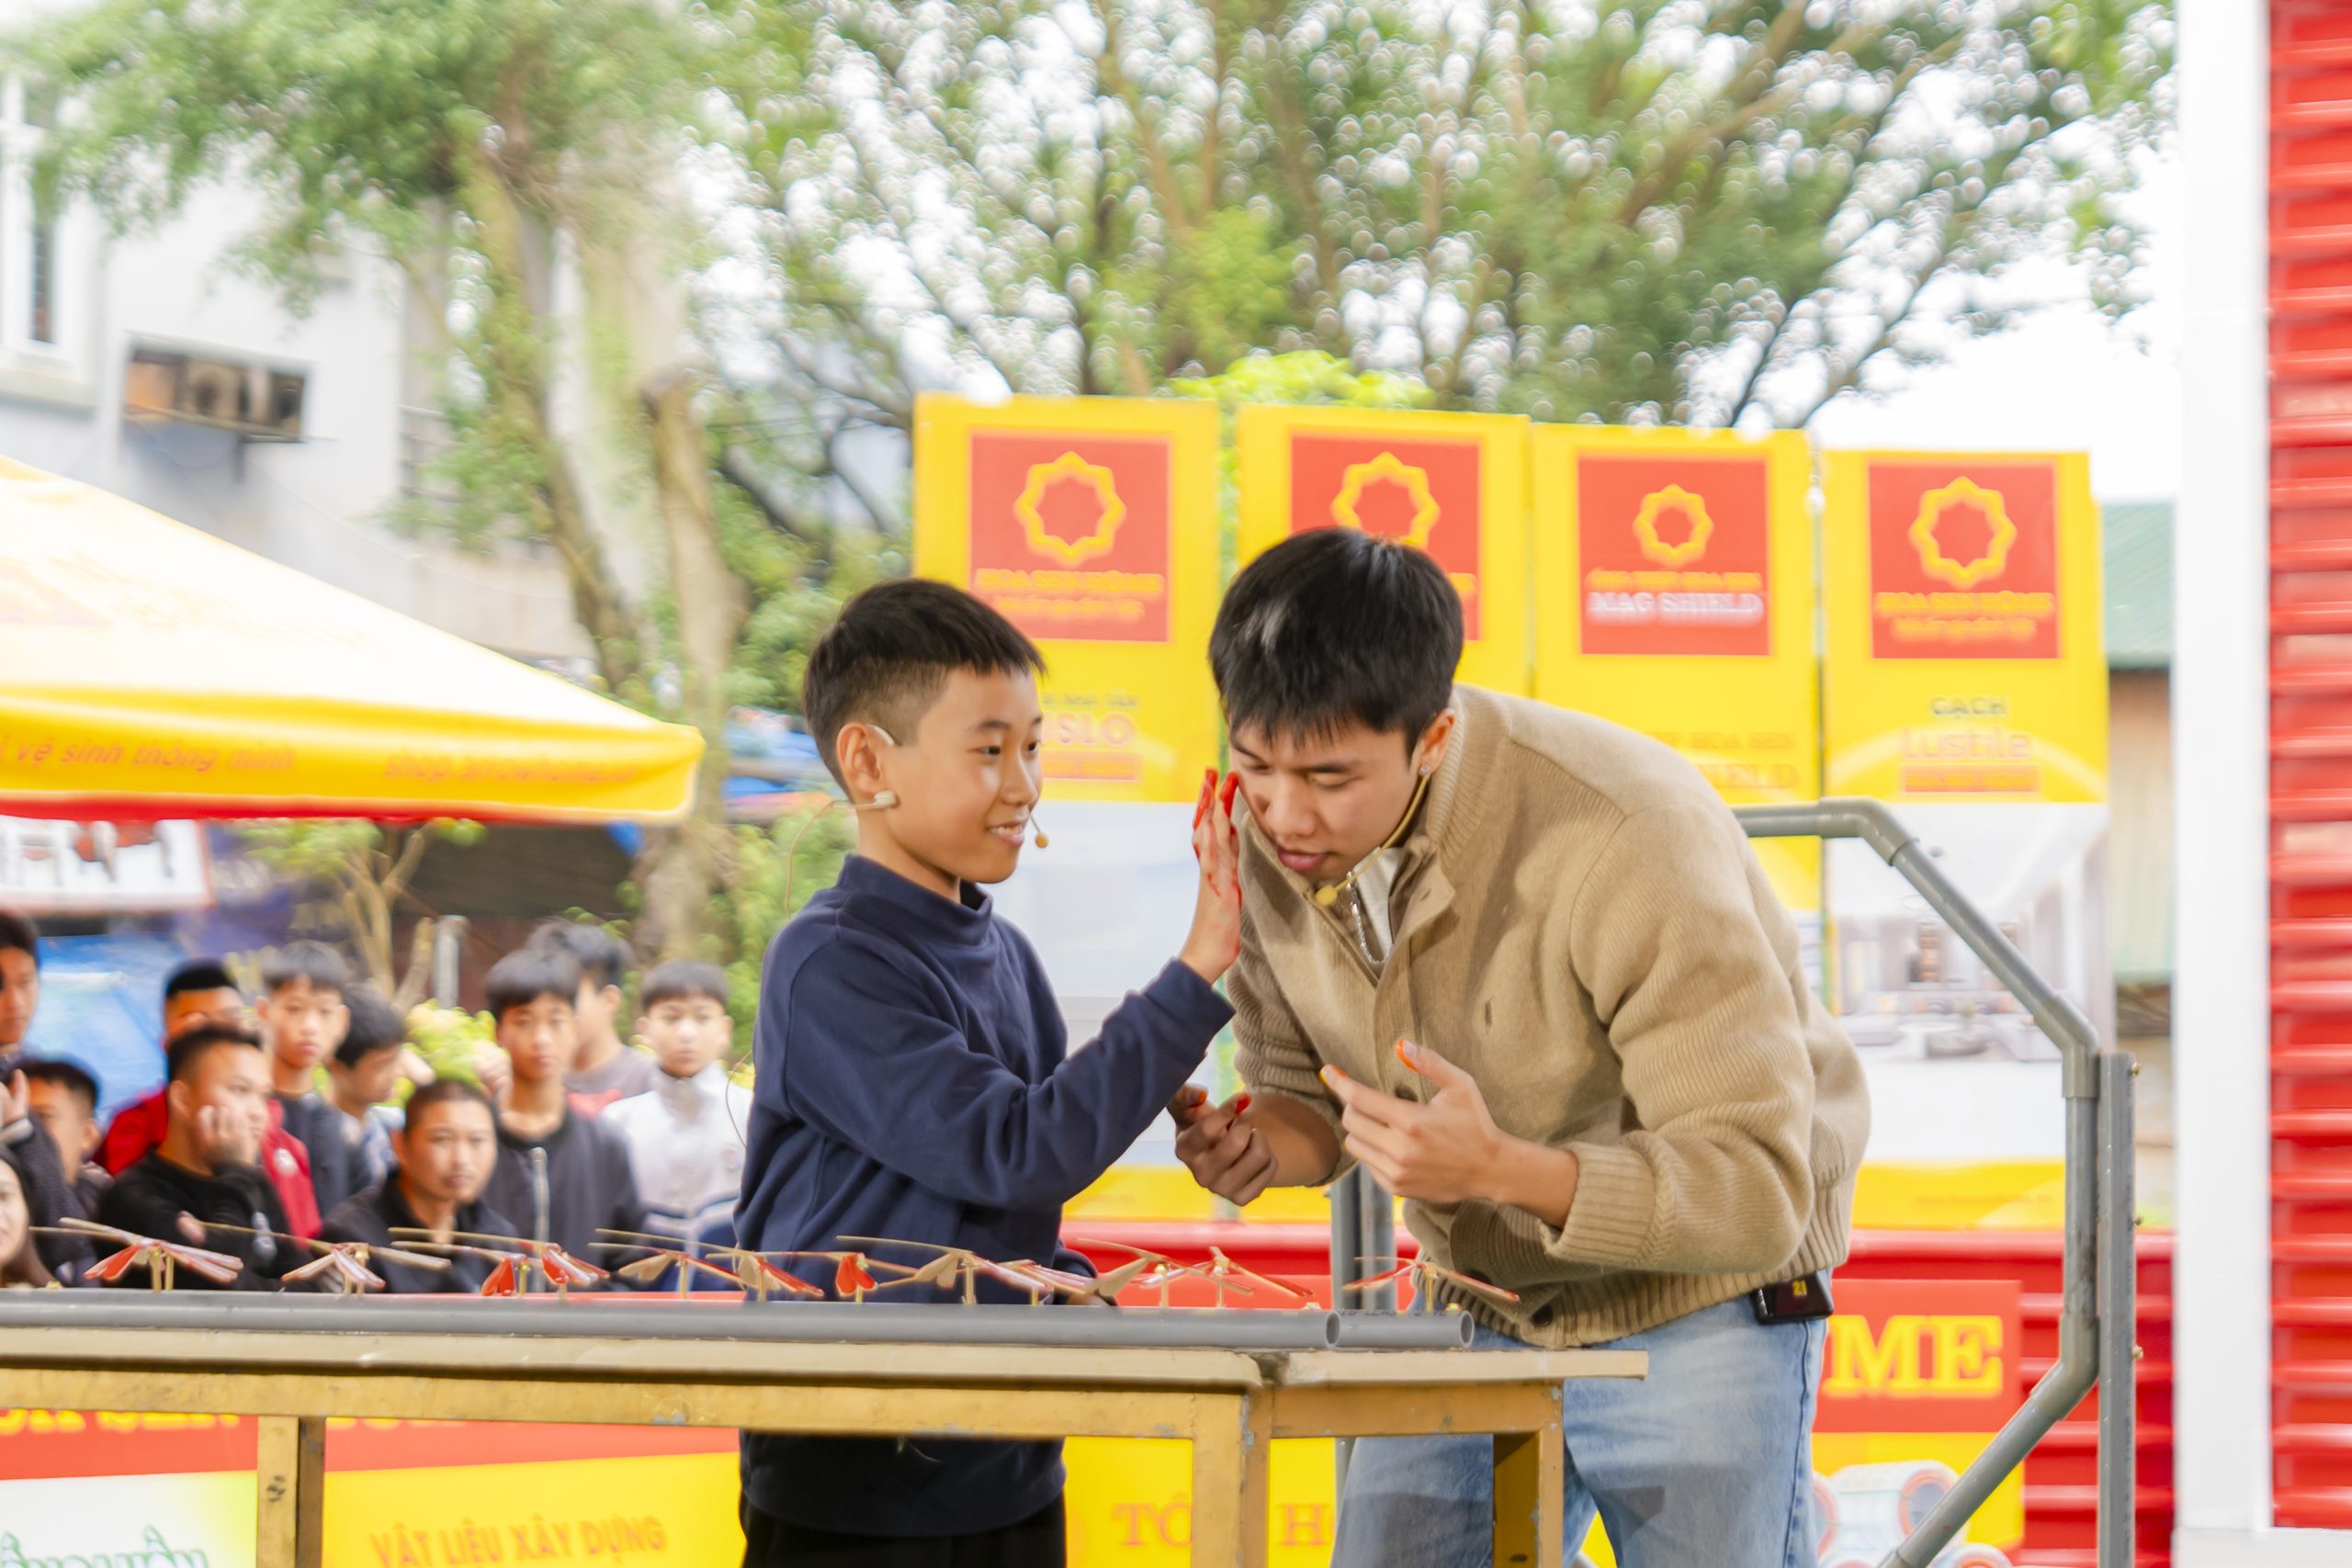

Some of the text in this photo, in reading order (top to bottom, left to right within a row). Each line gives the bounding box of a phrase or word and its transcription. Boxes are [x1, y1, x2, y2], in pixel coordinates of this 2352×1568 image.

[60, 739, 124, 765] sinh
[1823, 1314, 2004, 1397] ME
[508, 1512, 573, 1561] XÂY
[1111, 1492, 1193, 1549] TÔ
